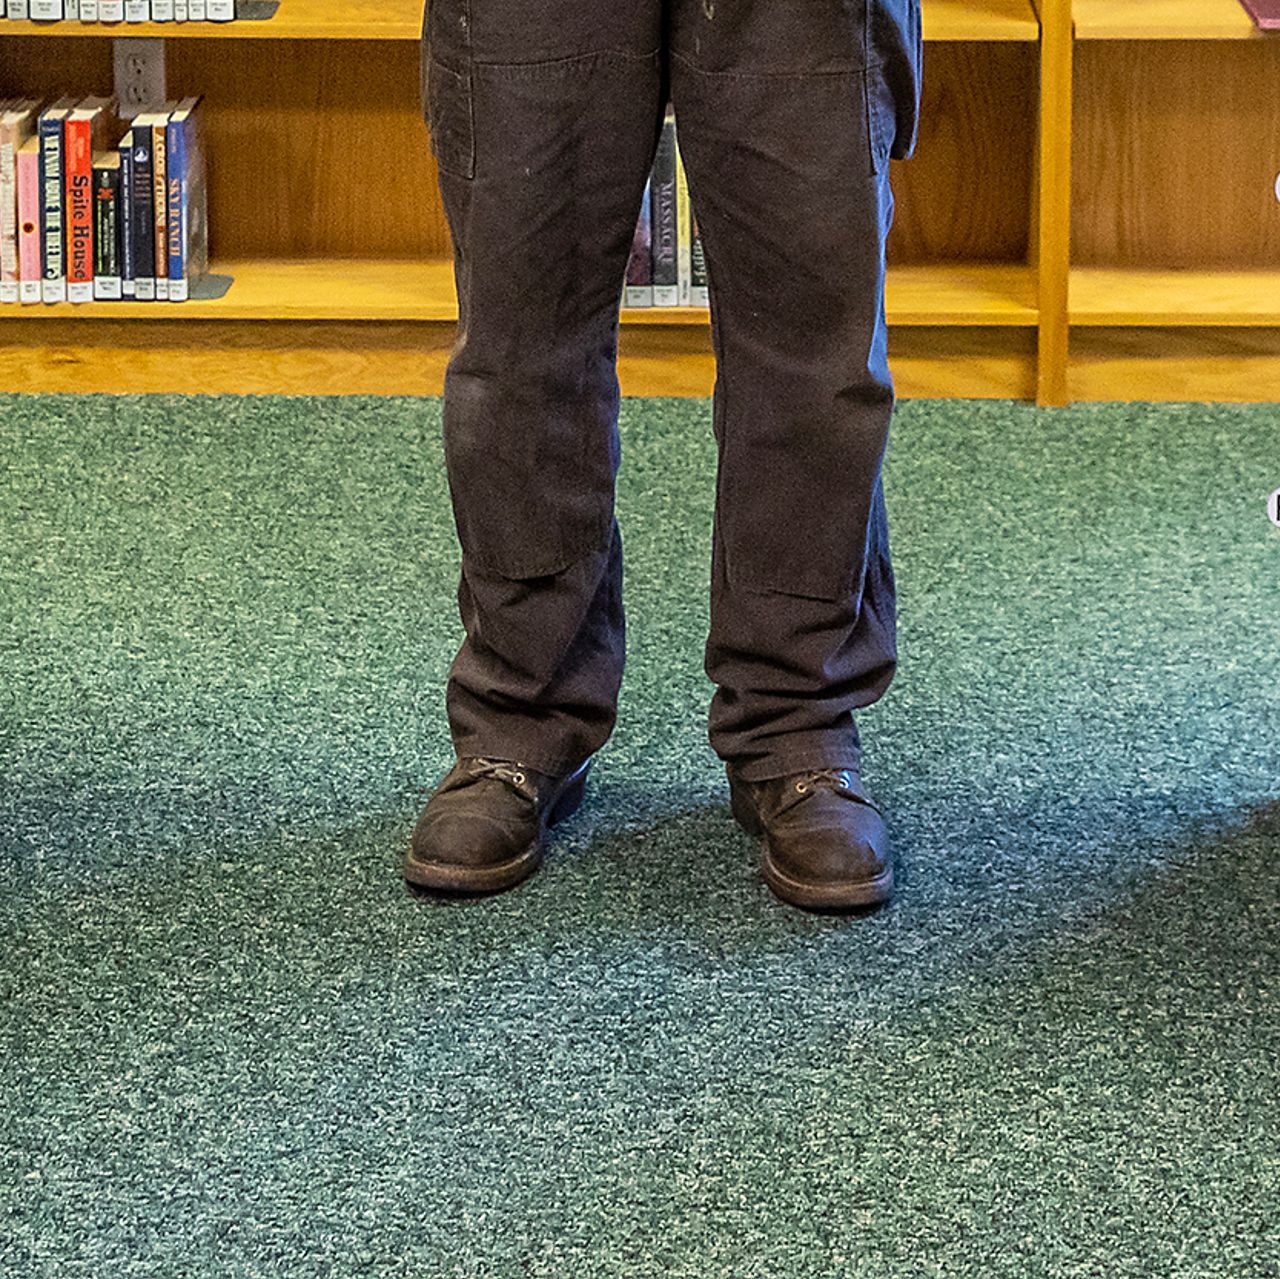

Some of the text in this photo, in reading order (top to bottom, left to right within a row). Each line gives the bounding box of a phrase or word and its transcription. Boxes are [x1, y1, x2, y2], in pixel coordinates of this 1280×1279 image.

[45, 134, 60, 178] VIETNAM
[45, 179, 60, 209] ABOVE
[45, 212, 60, 228] THE
[69, 175, 90, 279] Spite House
[169, 178, 180, 257] SKY RANCH
